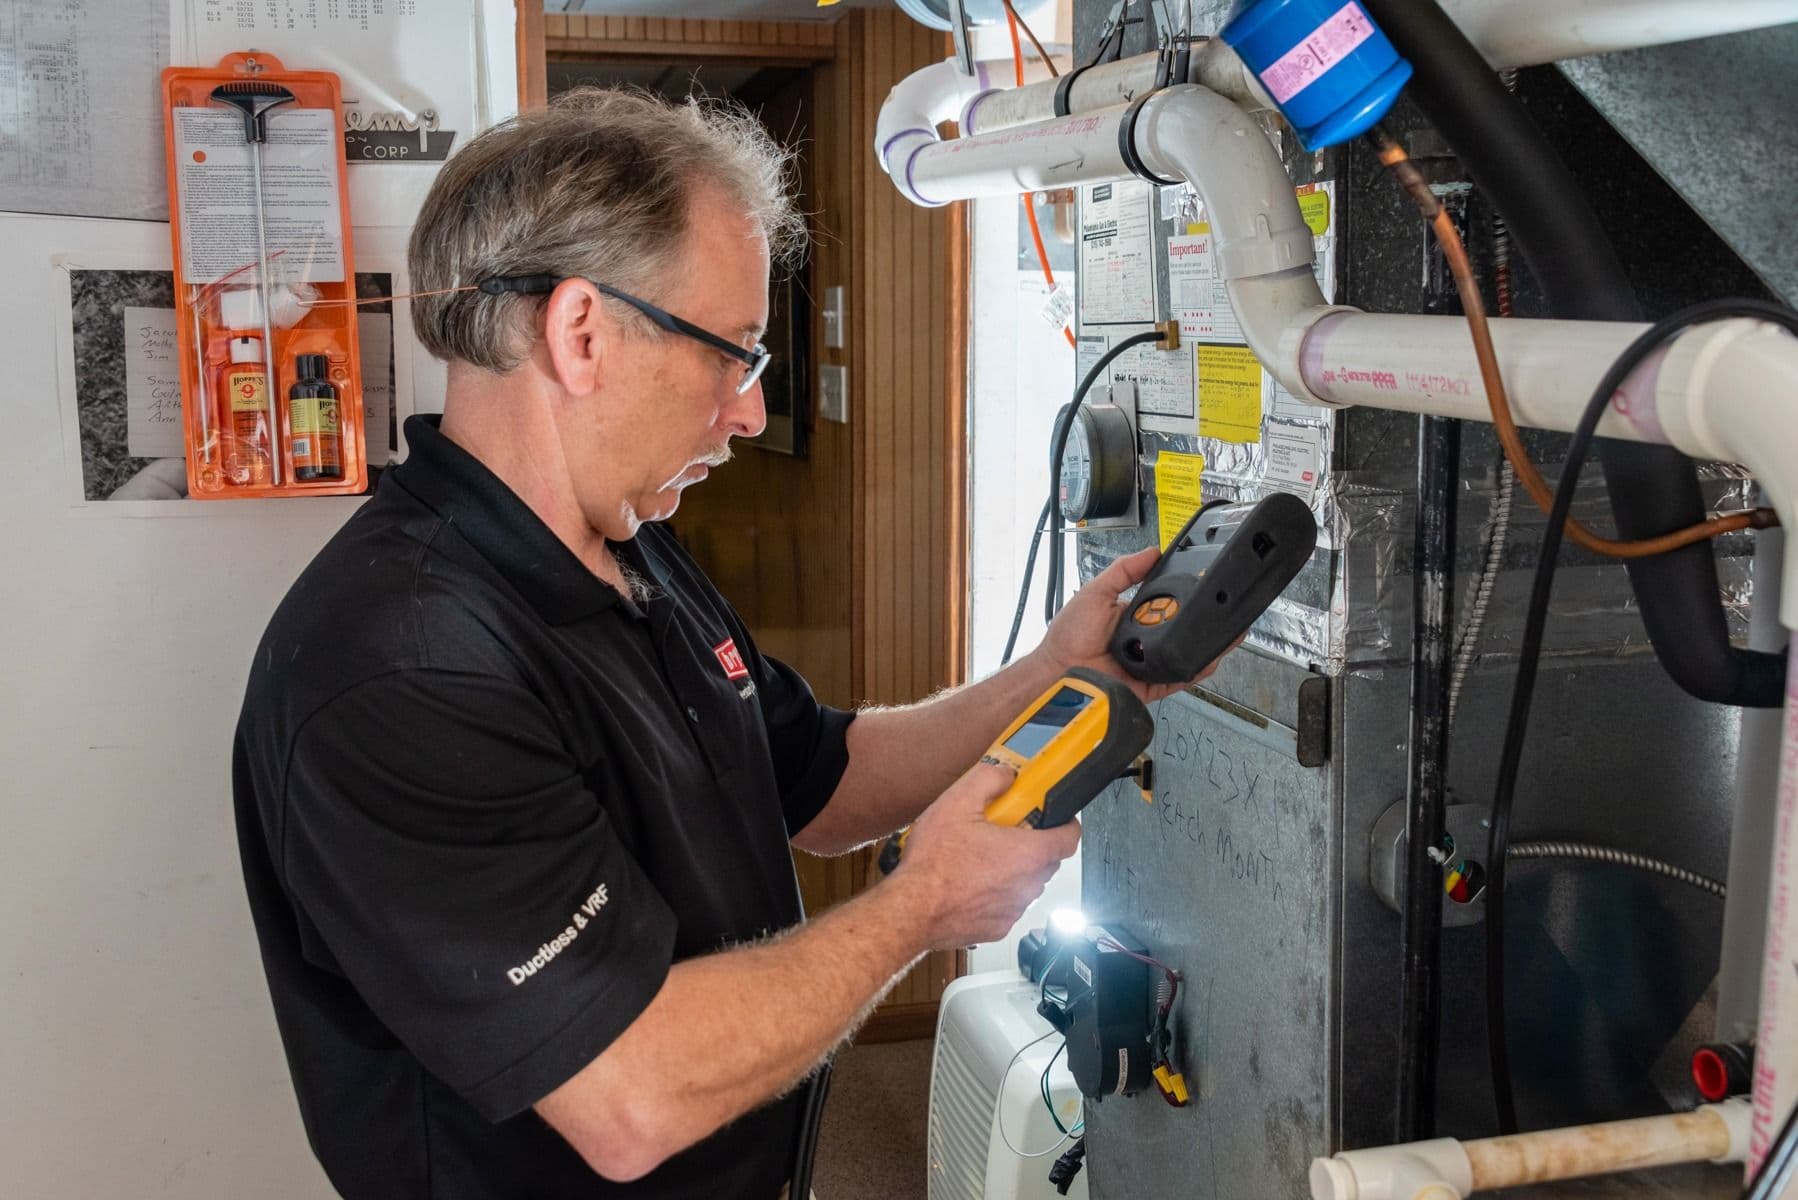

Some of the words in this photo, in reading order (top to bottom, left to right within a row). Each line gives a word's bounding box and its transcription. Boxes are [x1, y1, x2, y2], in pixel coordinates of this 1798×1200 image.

[363, 145, 409, 158] CORP
[1169, 239, 1208, 260] Important!
[507, 926, 578, 986] Ductless
[573, 913, 589, 930] &
[581, 883, 608, 916] VRF
